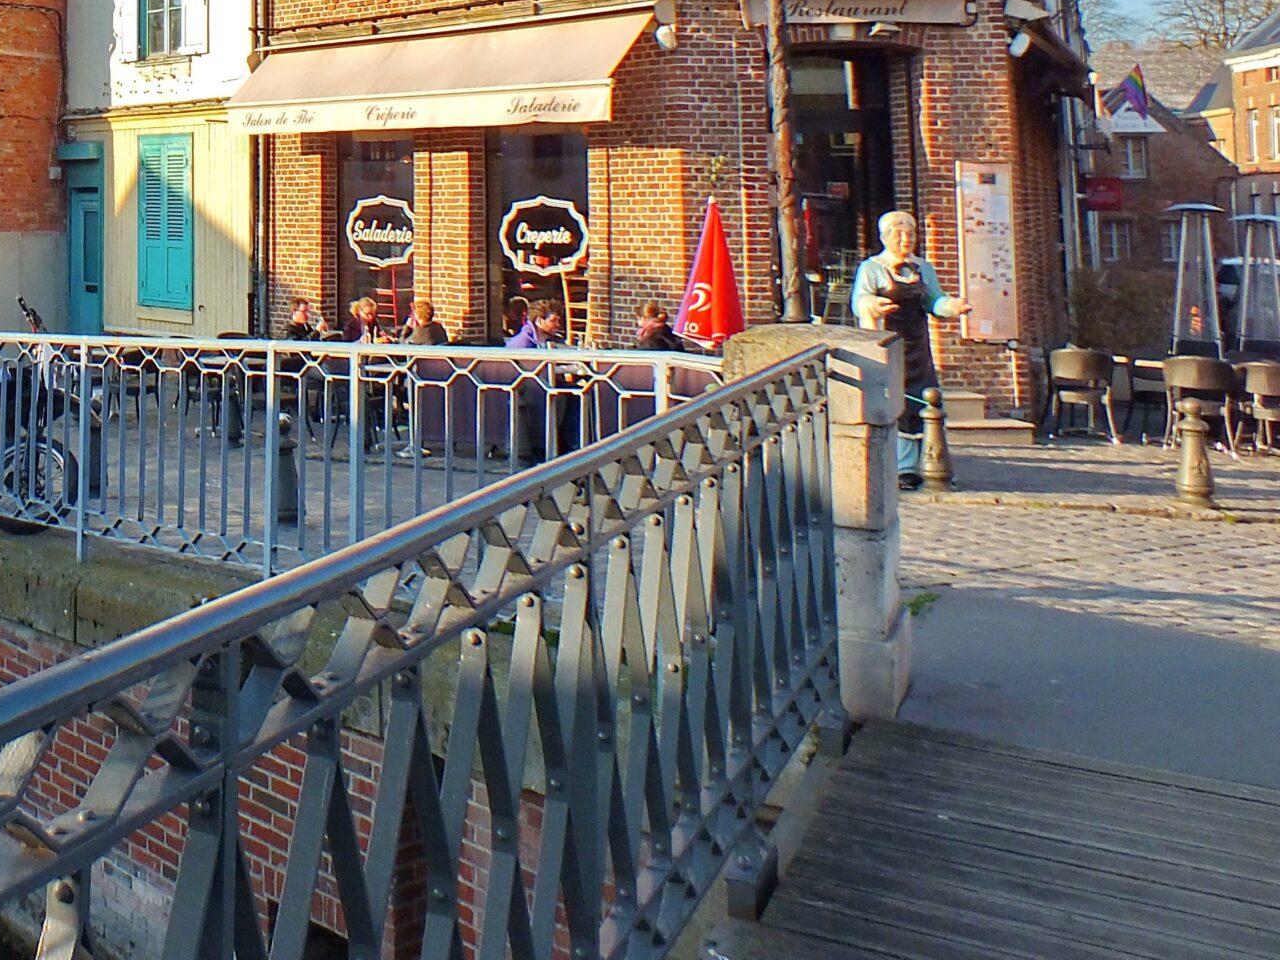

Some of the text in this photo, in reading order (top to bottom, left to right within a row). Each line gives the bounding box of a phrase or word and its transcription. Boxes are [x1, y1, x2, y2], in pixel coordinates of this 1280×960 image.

[506, 95, 582, 115] Saladerie
[242, 112, 272, 128] Salon
[275, 111, 289, 126] de
[352, 219, 413, 245] Saladerie
